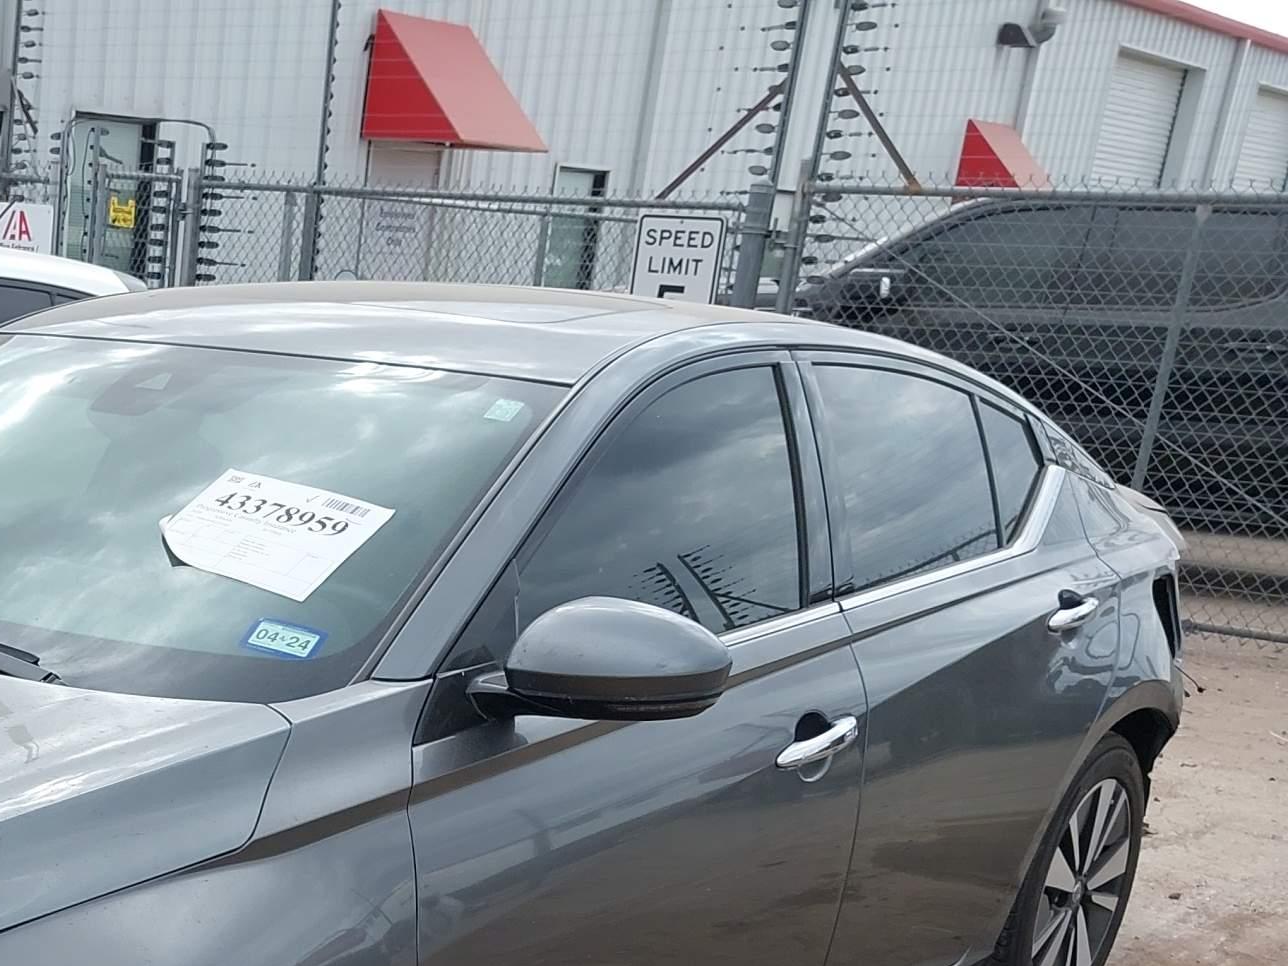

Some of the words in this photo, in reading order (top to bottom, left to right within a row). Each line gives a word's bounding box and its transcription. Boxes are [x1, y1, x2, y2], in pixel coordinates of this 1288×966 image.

[645, 229, 714, 248] SPEED
[648, 256, 703, 276] LIMIT
[215, 492, 349, 536] 43378959
